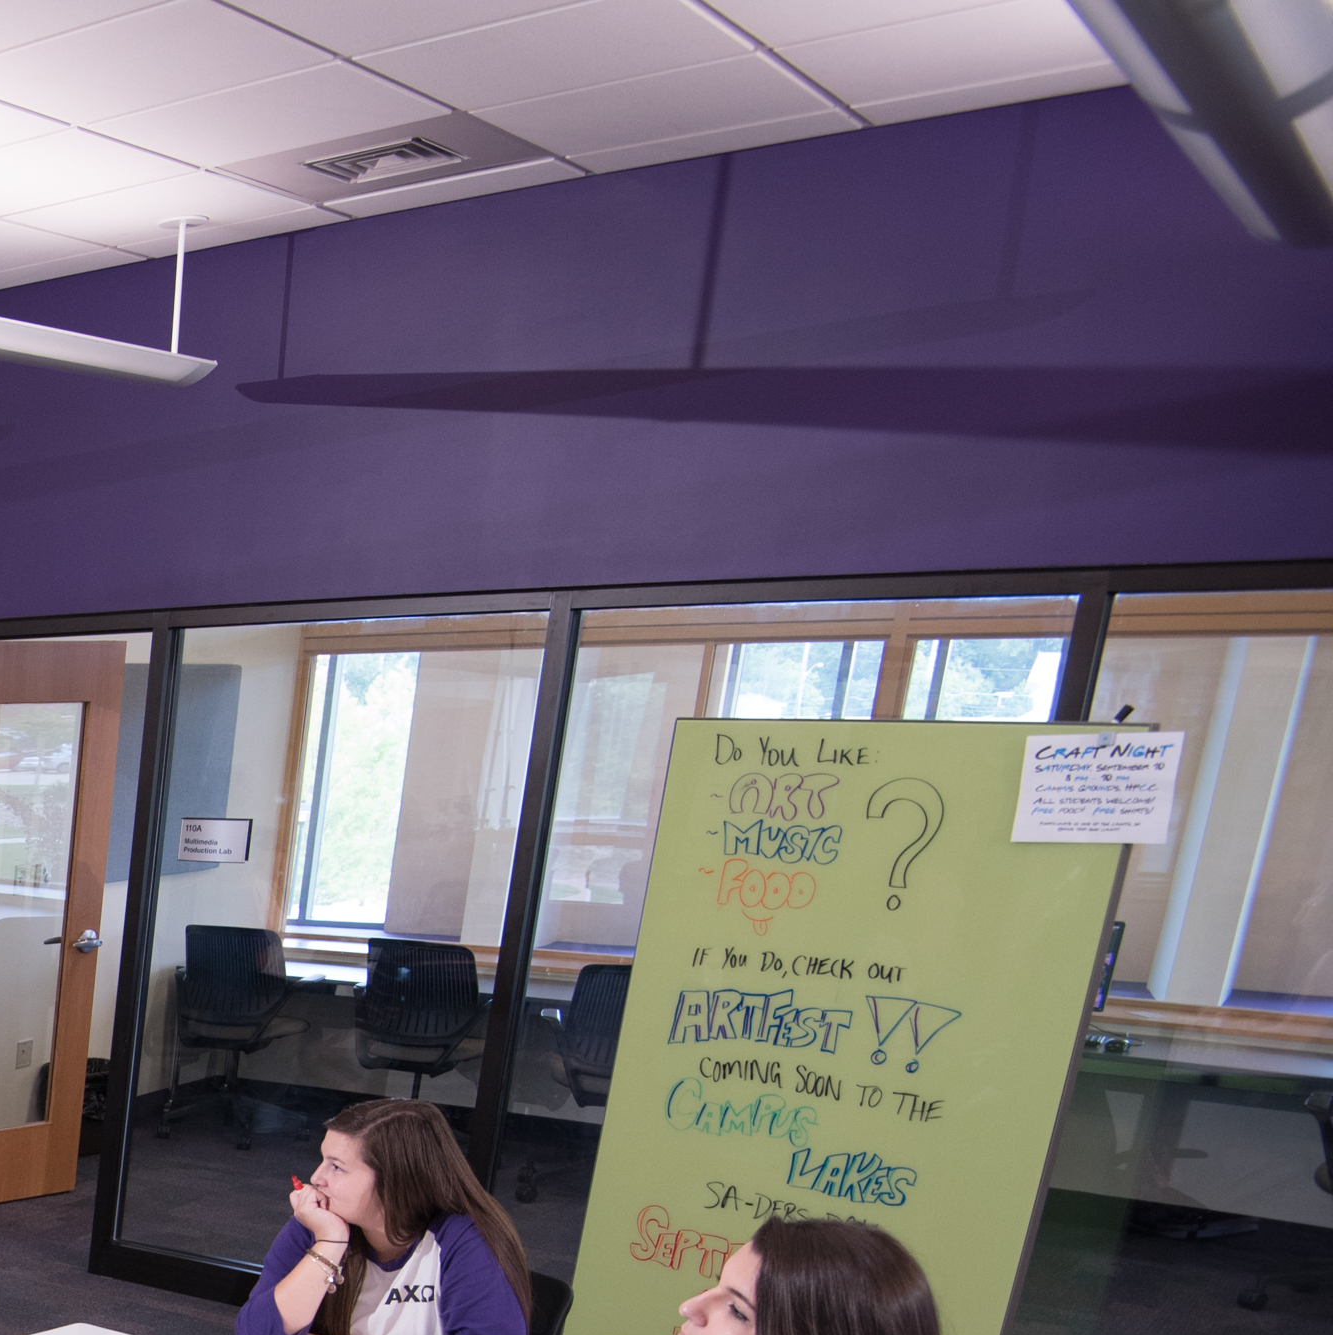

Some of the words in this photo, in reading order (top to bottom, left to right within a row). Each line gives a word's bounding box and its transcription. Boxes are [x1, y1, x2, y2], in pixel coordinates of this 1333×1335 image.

[1035, 745, 1107, 760] CRAFT
[1110, 743, 1175, 759] NIGHT
[1096, 763, 1149, 772] SEPTEMBER
[1153, 762, 1165, 770] 10
[1101, 774, 1112, 782] 10
[729, 772, 840, 821] ART
[184, 838, 218, 846] Multimedia
[185, 824, 202, 832] 110A
[723, 819, 843, 865] MUSIC
[183, 846, 217, 854] Production
[219, 847, 232, 855] Lab
[716, 858, 817, 910] FOOD
[693, 948, 709, 968] IF
[791, 953, 854, 980] CHECK
[867, 963, 907, 983] OUT
[795, 1065, 842, 1101] SOON
[856, 1084, 883, 1108] TO
[893, 1091, 946, 1123] THE
[665, 1077, 818, 1147] CAMPUS
[787, 1148, 917, 1207] LAKES
